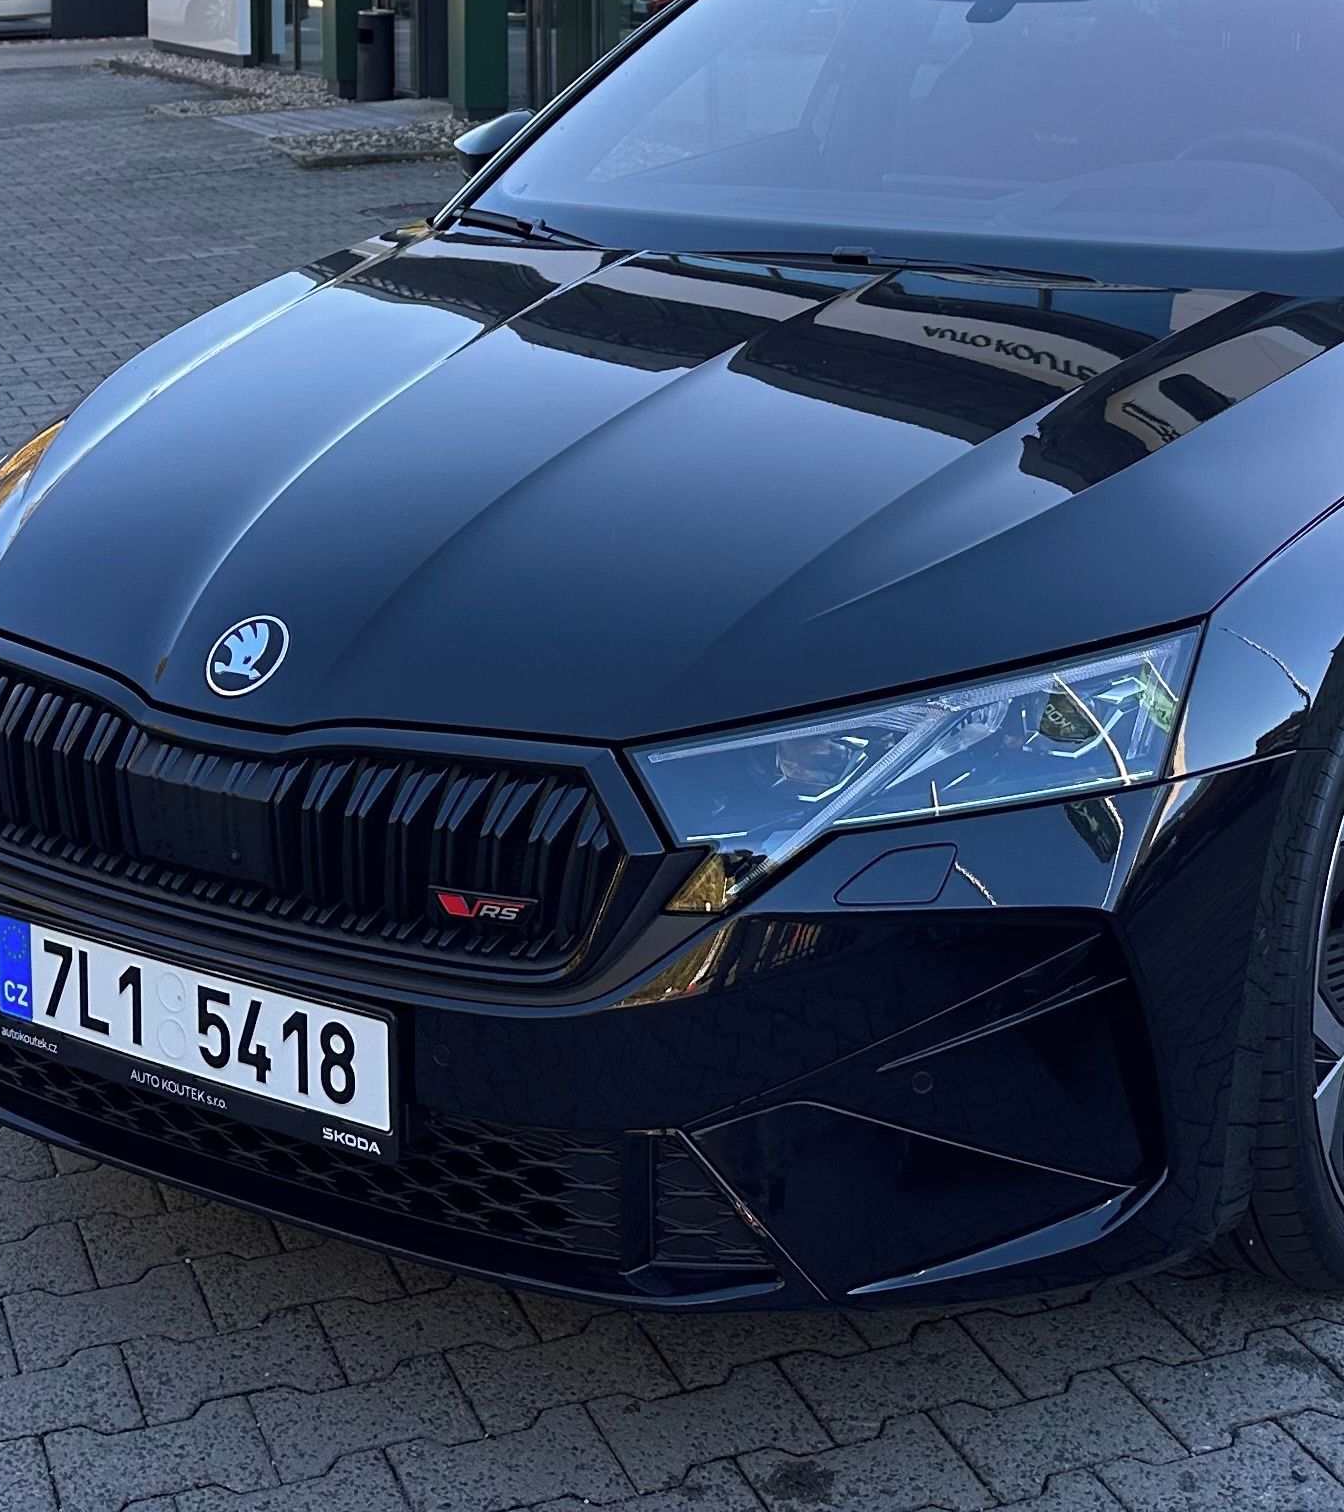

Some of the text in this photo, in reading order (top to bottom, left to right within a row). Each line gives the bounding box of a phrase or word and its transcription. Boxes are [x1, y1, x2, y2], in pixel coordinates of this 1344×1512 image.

[3, 980, 29, 1007] CZ
[43, 938, 357, 1105] 7L1 5418
[1, 1026, 58, 1054] autokoutek.cz
[130, 1069, 228, 1110] AUTO KOUTEK s.r.o.
